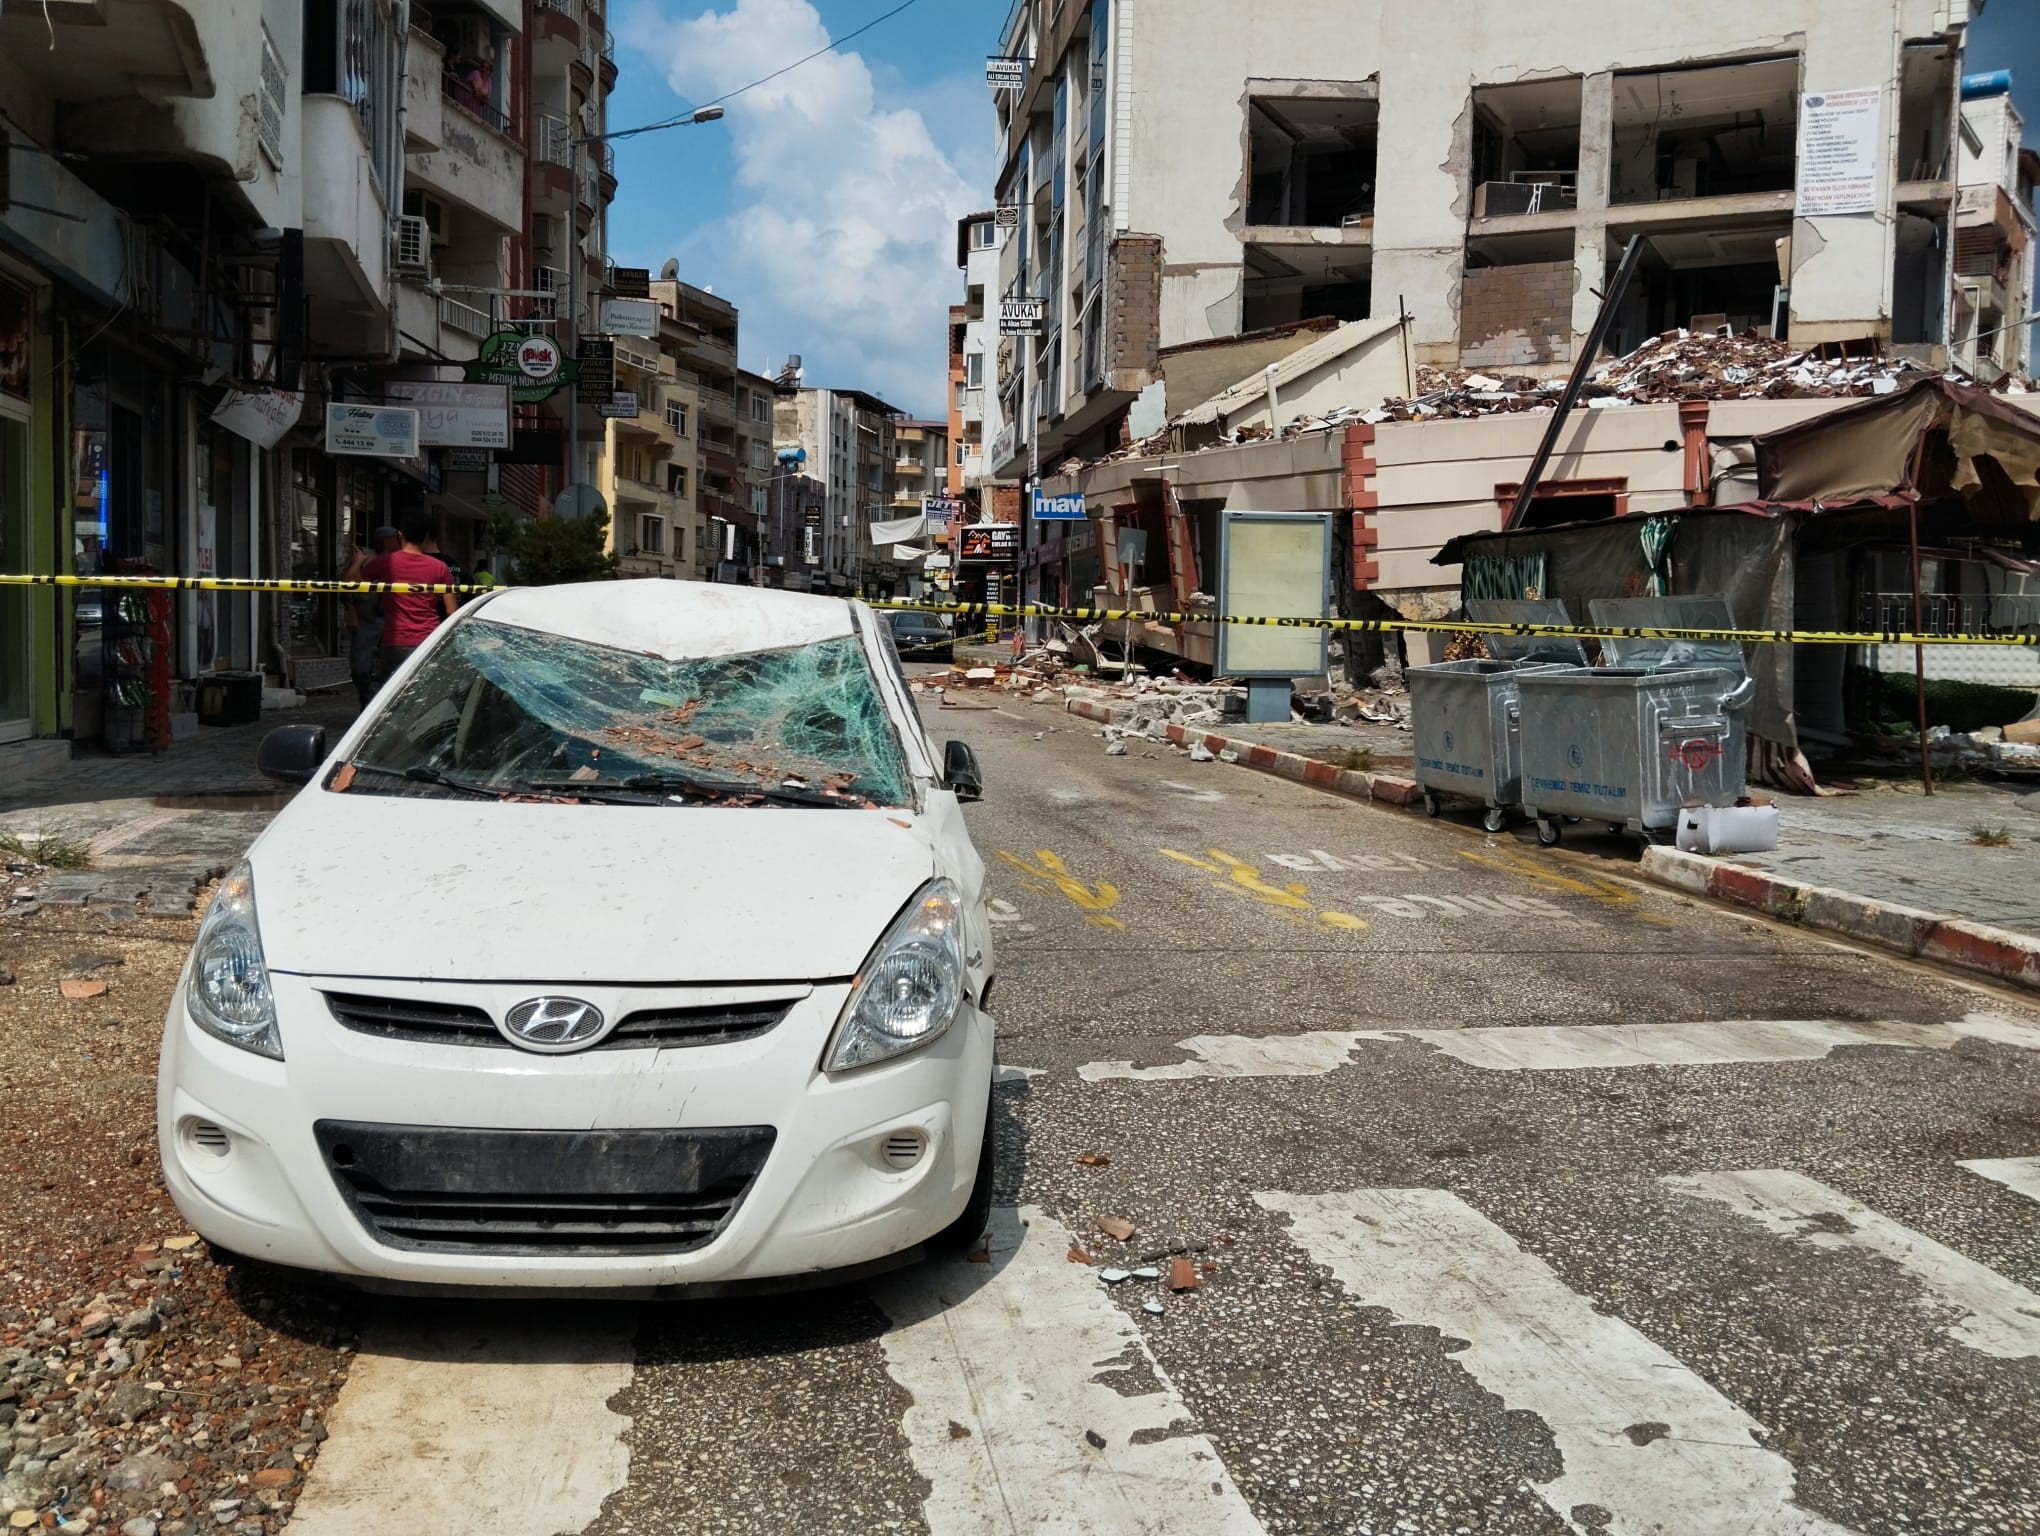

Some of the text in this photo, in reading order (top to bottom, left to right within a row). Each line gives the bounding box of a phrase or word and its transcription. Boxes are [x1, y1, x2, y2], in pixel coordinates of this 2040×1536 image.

[1001, 304, 1039, 318] AVUKAT
[1035, 494, 1086, 512] mavi
[1569, 782, 1591, 794] TEMİZ
[1593, 784, 1628, 798] TUTALIM
